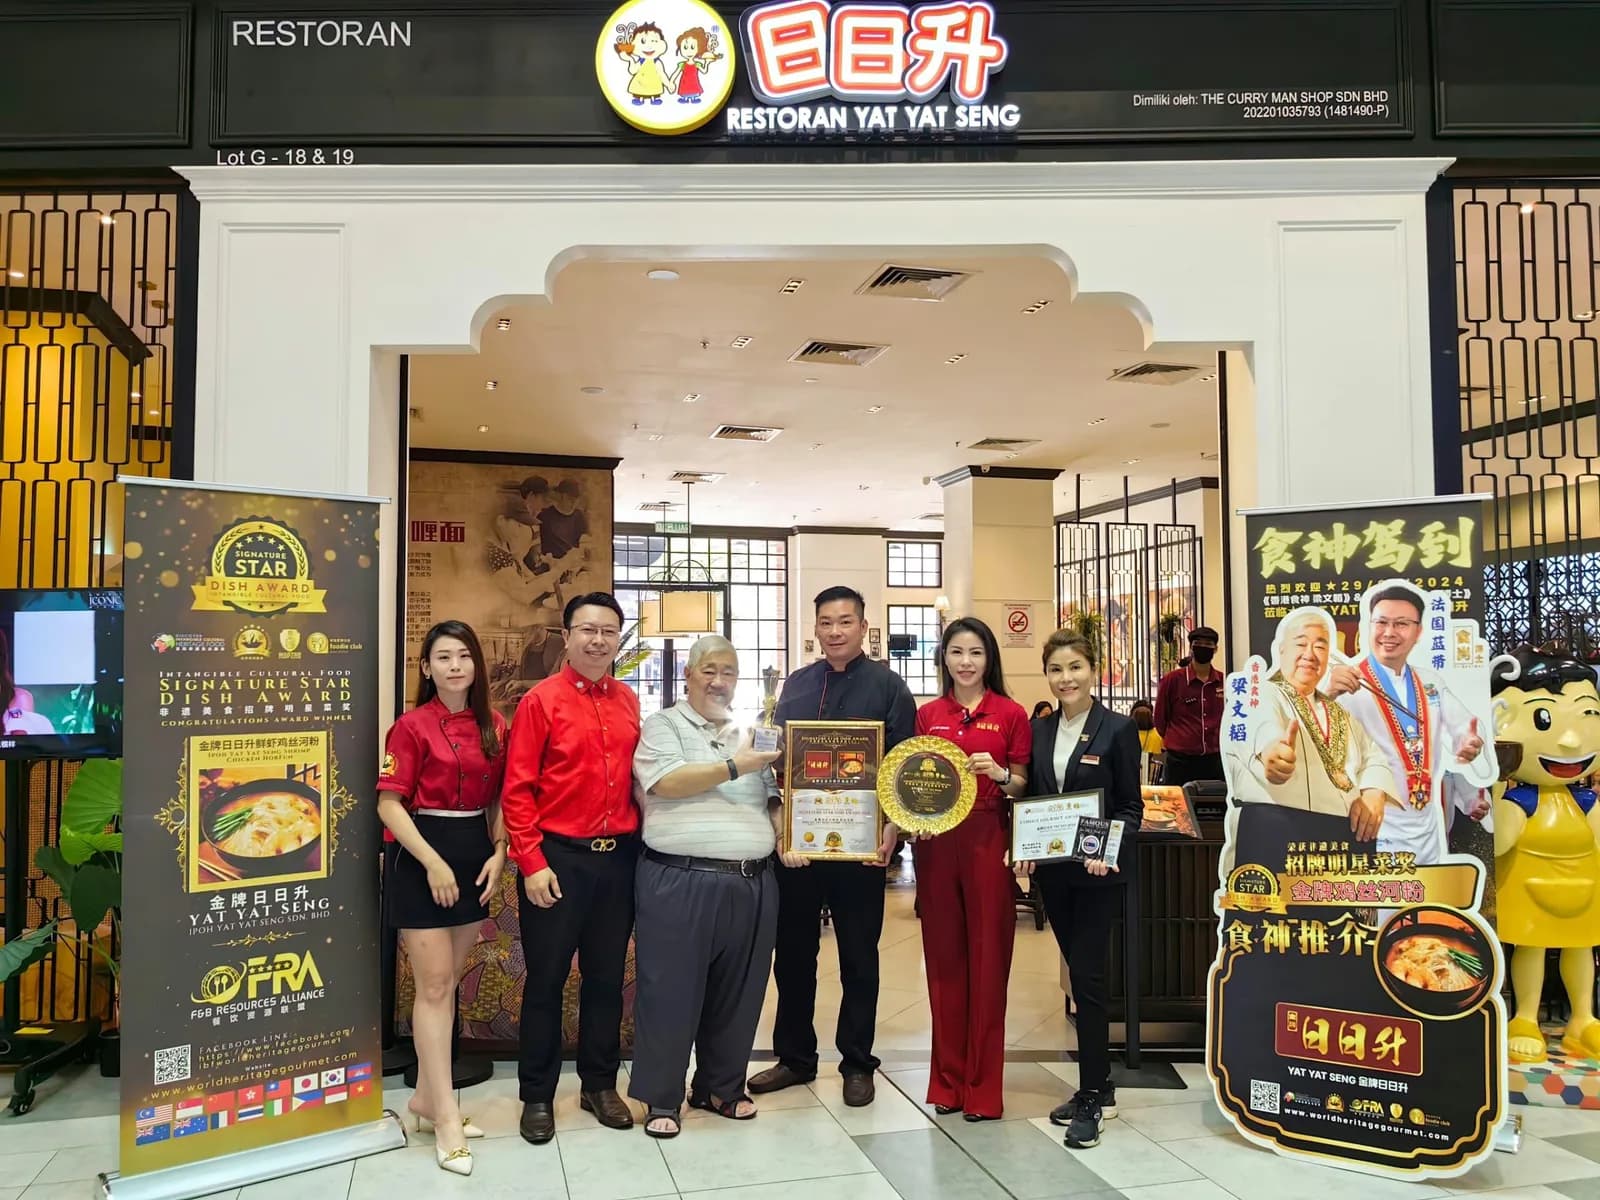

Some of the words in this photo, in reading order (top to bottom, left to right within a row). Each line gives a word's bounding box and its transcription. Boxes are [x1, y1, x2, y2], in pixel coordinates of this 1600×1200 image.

[232, 20, 412, 48] RESTORAN
[750, 2, 1003, 105] 日日升
[1133, 95, 1171, 107] Dimiliki
[1172, 94, 1198, 106] oleh:
[1201, 93, 1225, 105] THE
[1227, 93, 1267, 105] CURRY
[1271, 92, 1298, 104] MAN
[1300, 92, 1333, 104] SHOP
[1335, 91, 1361, 103] SDN
[1363, 90, 1388, 102] BHD
[727, 108, 848, 130] RESTORAN
[853, 107, 898, 129] YAT
[905, 106, 950, 128] YAT
[956, 105, 1021, 128] SENG
[1243, 106, 1320, 118] 202201035793
[1324, 104, 1389, 118] (1481490-P)
[216, 149, 246, 166] Lot
[250, 149, 266, 166] G
[285, 149, 306, 166] 18
[312, 149, 326, 166] &
[332, 149, 354, 166] 19
[235, 550, 287, 560] SIGNATURE
[1252, 516, 1474, 579] 食神驾到
[235, 560, 288, 577] STAR
[211, 581, 248, 592] DISH
[256, 583, 310, 593] AWARD
[1330, 604, 1358, 616] YAT
[160, 679, 288, 692] SIGNATURE
[300, 677, 350, 689] STAR
[161, 692, 232, 706] DISH
[257, 690, 351, 704] AWARD
[161, 717, 270, 727] CONGRATULATIONS
[1286, 852, 1416, 876] 招牌明星菜奖
[209, 884, 309, 911] 金牌日日升
[1240, 883, 1265, 893] STAR
[1291, 880, 1425, 902] 金牌鸡丝河粉
[189, 910, 228, 926] YAT
[237, 904, 272, 920] YAT
[281, 897, 329, 915] SENG
[217, 923, 234, 933] YAT
[239, 920, 257, 931] YAT
[260, 917, 284, 928] SENG
[287, 914, 306, 924] SDN
[311, 910, 330, 921] BHD
[190, 1009, 212, 1020] F&B
[216, 996, 277, 1016] RESOURCES
[279, 988, 325, 1004] ALLIANCE
[199, 1038, 257, 1054] FACEBOOK
[1302, 1015, 1407, 1067] 日日升
[151, 1050, 358, 1100] www.worldheritagegourmet.com
[1287, 1065, 1306, 1078] YAT
[1308, 1067, 1328, 1081] YAT
[1329, 1071, 1356, 1085] SENG
[1358, 1075, 1409, 1094] 金牌日日升
[1284, 1107, 1449, 1142] www.worldheritagegourmet.com
